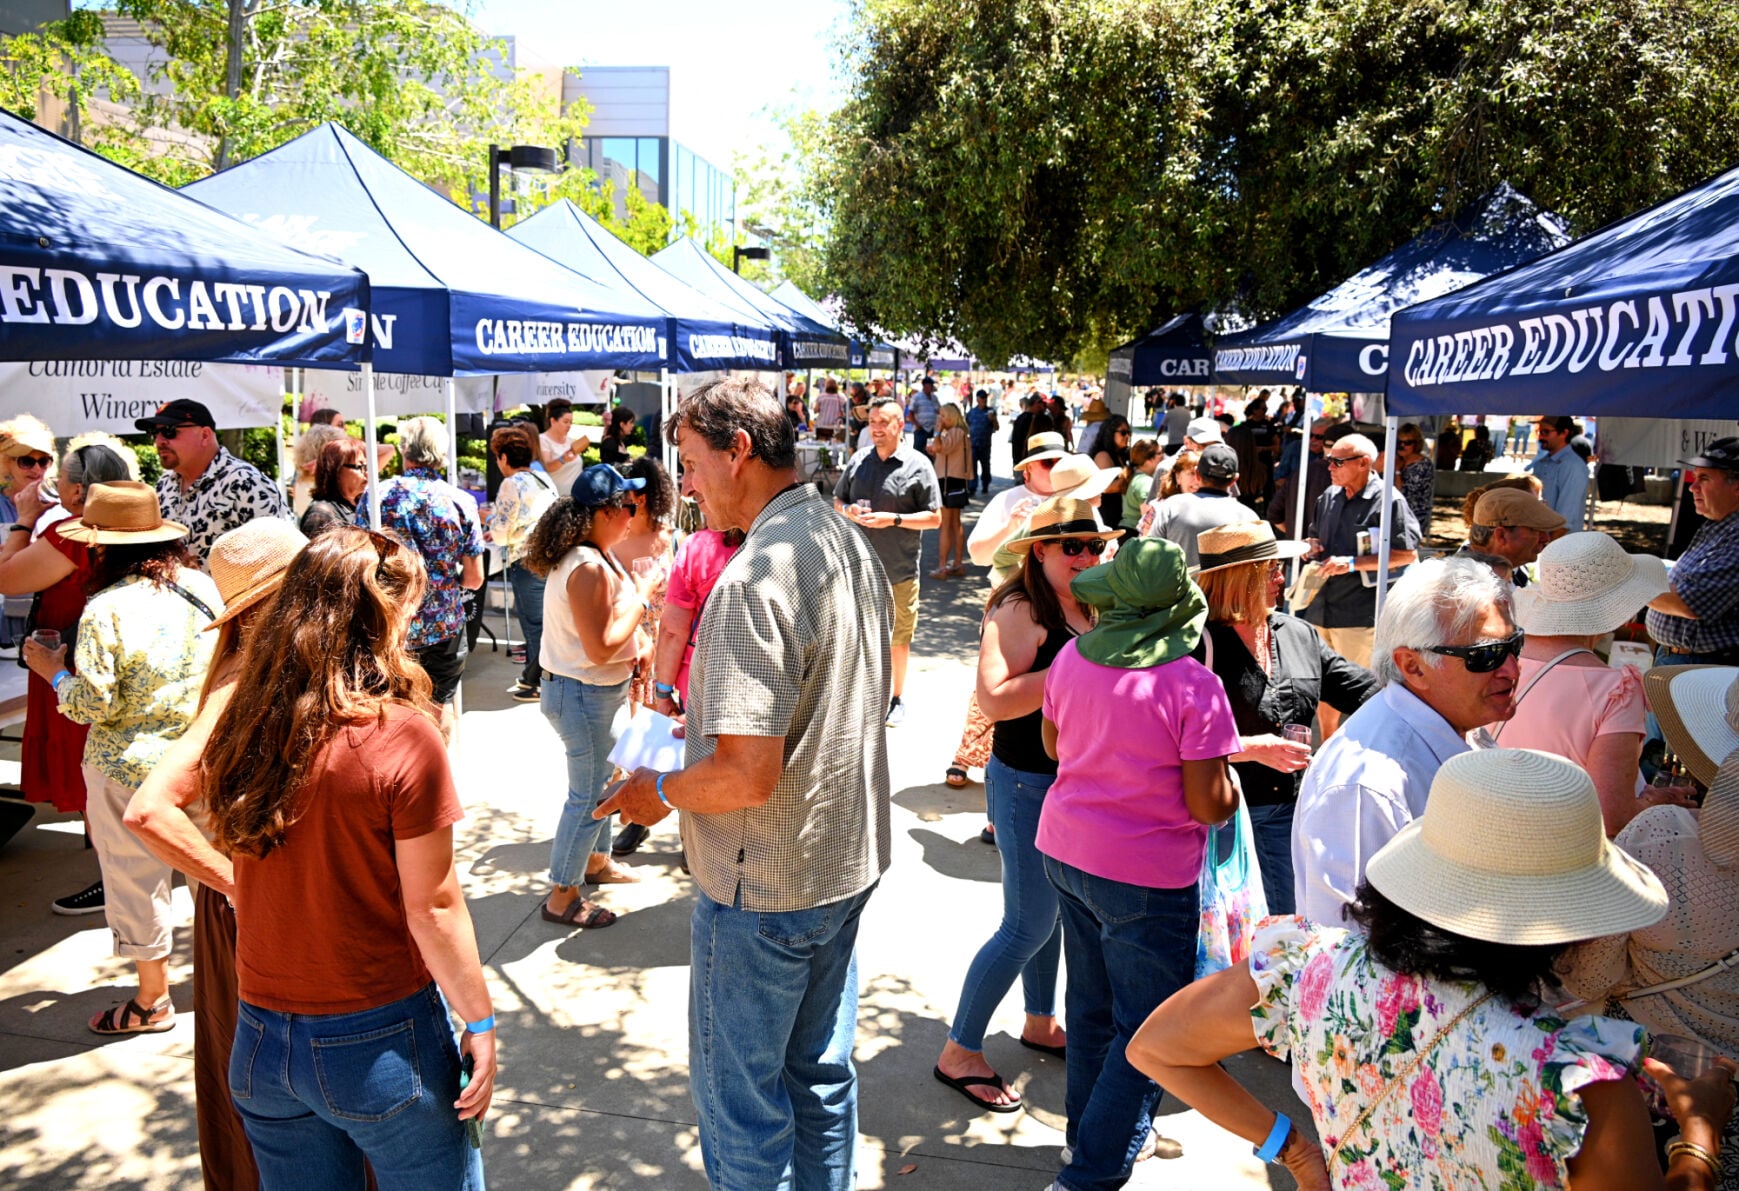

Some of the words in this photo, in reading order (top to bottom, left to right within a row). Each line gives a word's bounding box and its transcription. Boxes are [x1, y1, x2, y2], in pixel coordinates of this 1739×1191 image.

[0, 264, 331, 334] EDUCATION
[475, 318, 566, 355] CAREER
[567, 323, 656, 353] EDUCATION
[1404, 323, 1515, 388] CAREER
[1509, 282, 1739, 376] EDUCATI
[139, 360, 203, 378] Estate
[1240, 344, 1301, 372] EDUCATION
[346, 371, 386, 392] Sile
[1681, 429, 1690, 453] &
[1694, 431, 1717, 455] W
